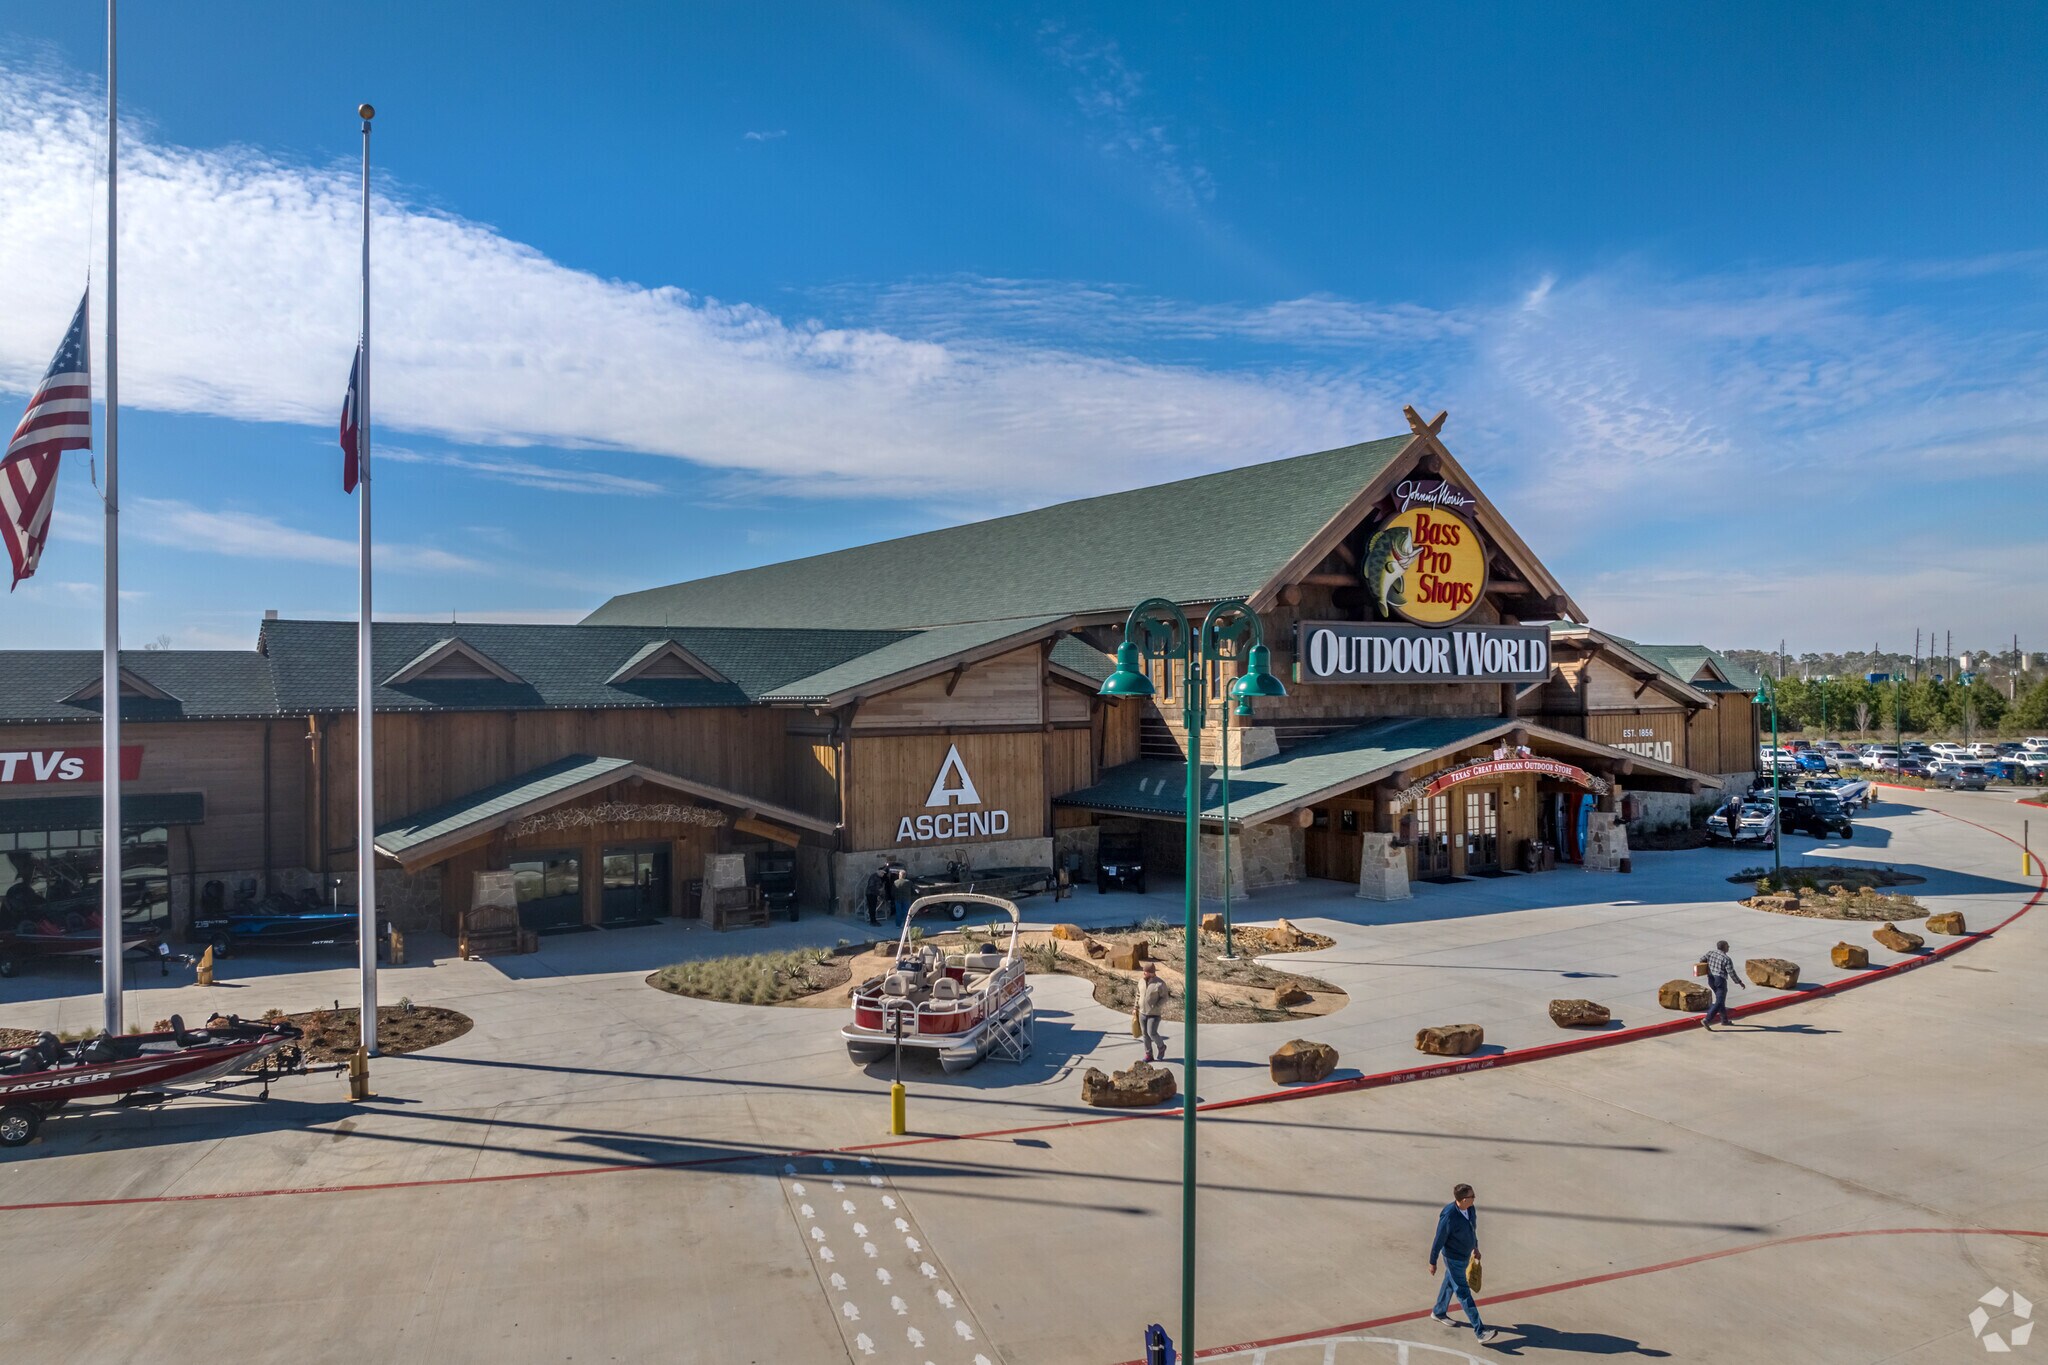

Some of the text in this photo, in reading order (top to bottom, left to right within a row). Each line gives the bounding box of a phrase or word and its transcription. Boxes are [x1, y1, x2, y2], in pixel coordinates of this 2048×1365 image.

[1396, 480, 1475, 513] Johnny Morris
[1414, 513, 1460, 546] Bass
[1416, 545, 1452, 574] Pro
[1417, 574, 1473, 611] Shops
[1310, 629, 1547, 677] OUTDOOR WORLD
[1623, 728, 1654, 738] EST. 1856
[1473, 764, 1493, 775] GREAT
[1493, 762, 1523, 771] AMERICAN
[1524, 761, 1553, 771] OUTDOOR
[1554, 763, 1572, 775] STORE
[896, 810, 1009, 842] ASCEND
